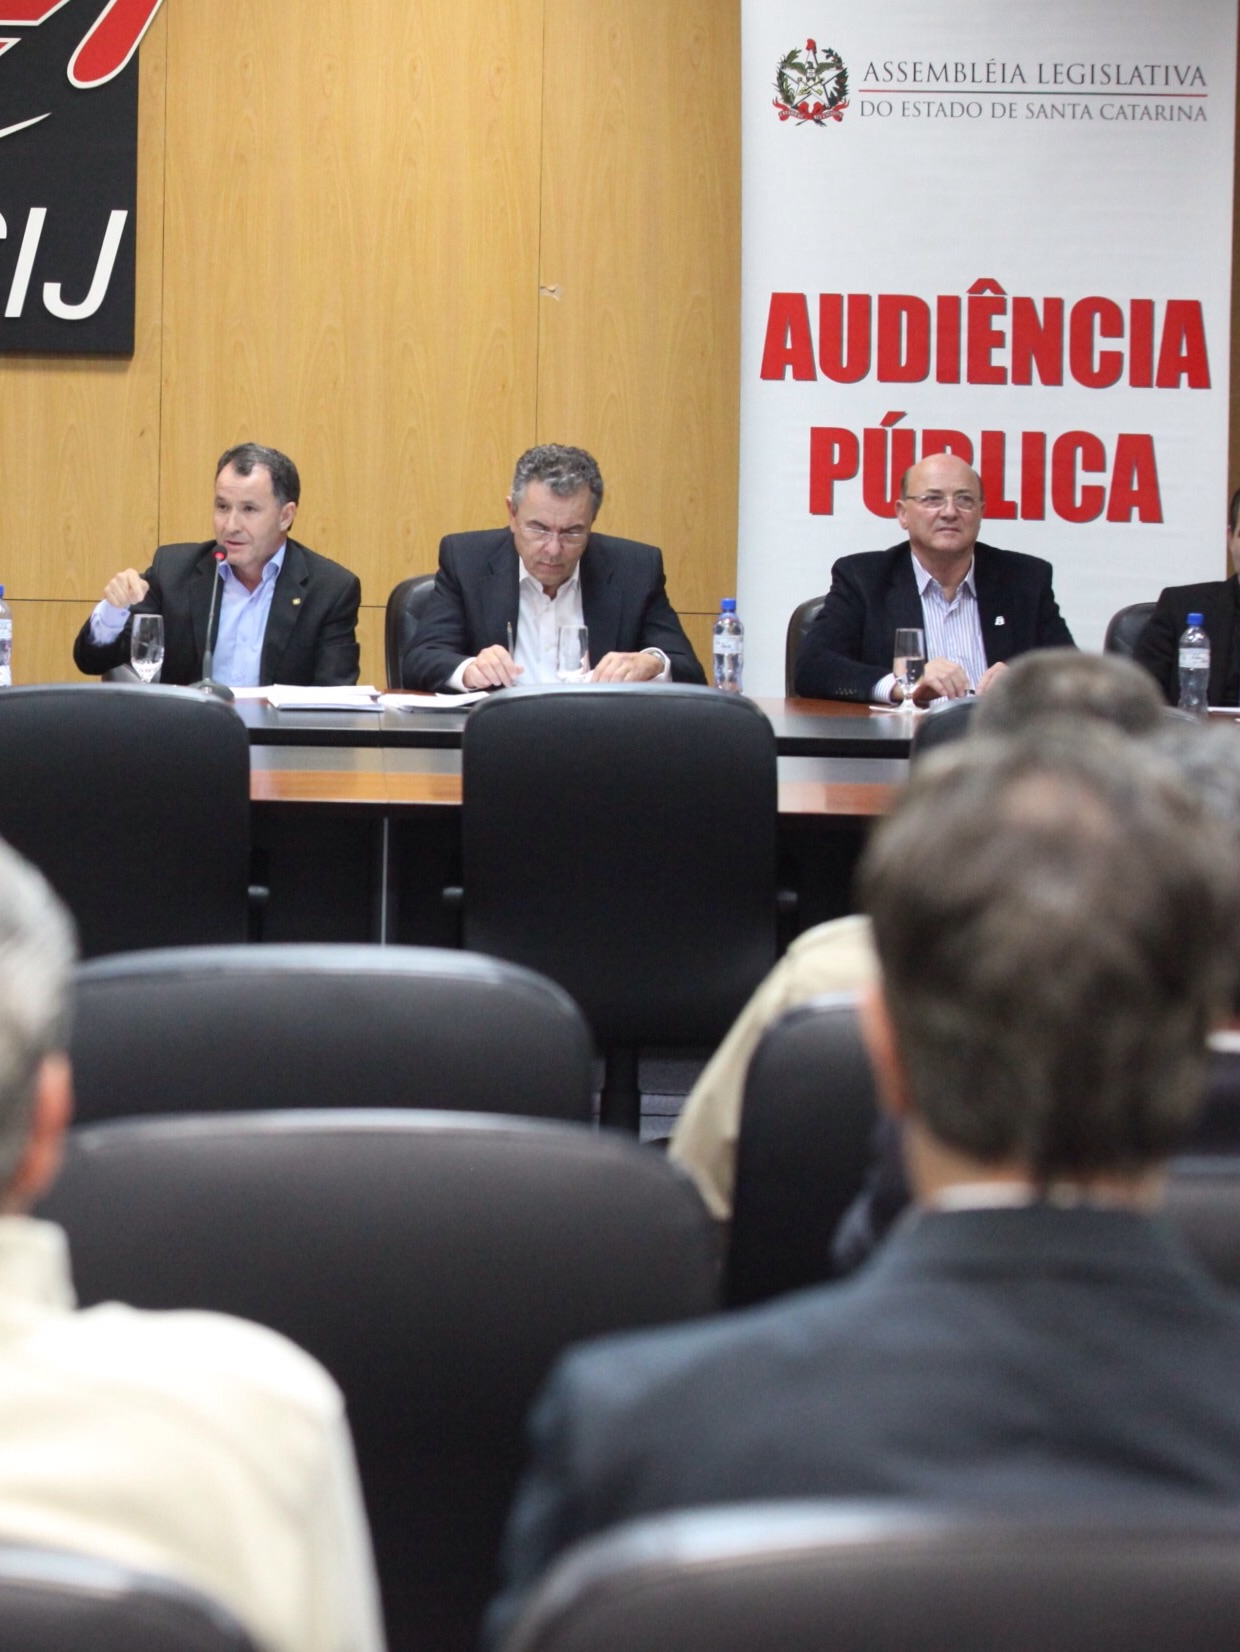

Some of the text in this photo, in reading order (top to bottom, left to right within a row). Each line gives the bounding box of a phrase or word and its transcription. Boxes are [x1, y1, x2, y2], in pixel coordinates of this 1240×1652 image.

[863, 58, 1207, 87] ASSEMBLÉIA LEGISLATIVA
[860, 100, 893, 117] DO
[901, 101, 983, 118] ESTADO
[991, 102, 1018, 119] DE
[1025, 102, 1093, 120] SANTA
[1099, 103, 1208, 122] CATARINA
[760, 278, 1211, 389] AUDIÊNCIA
